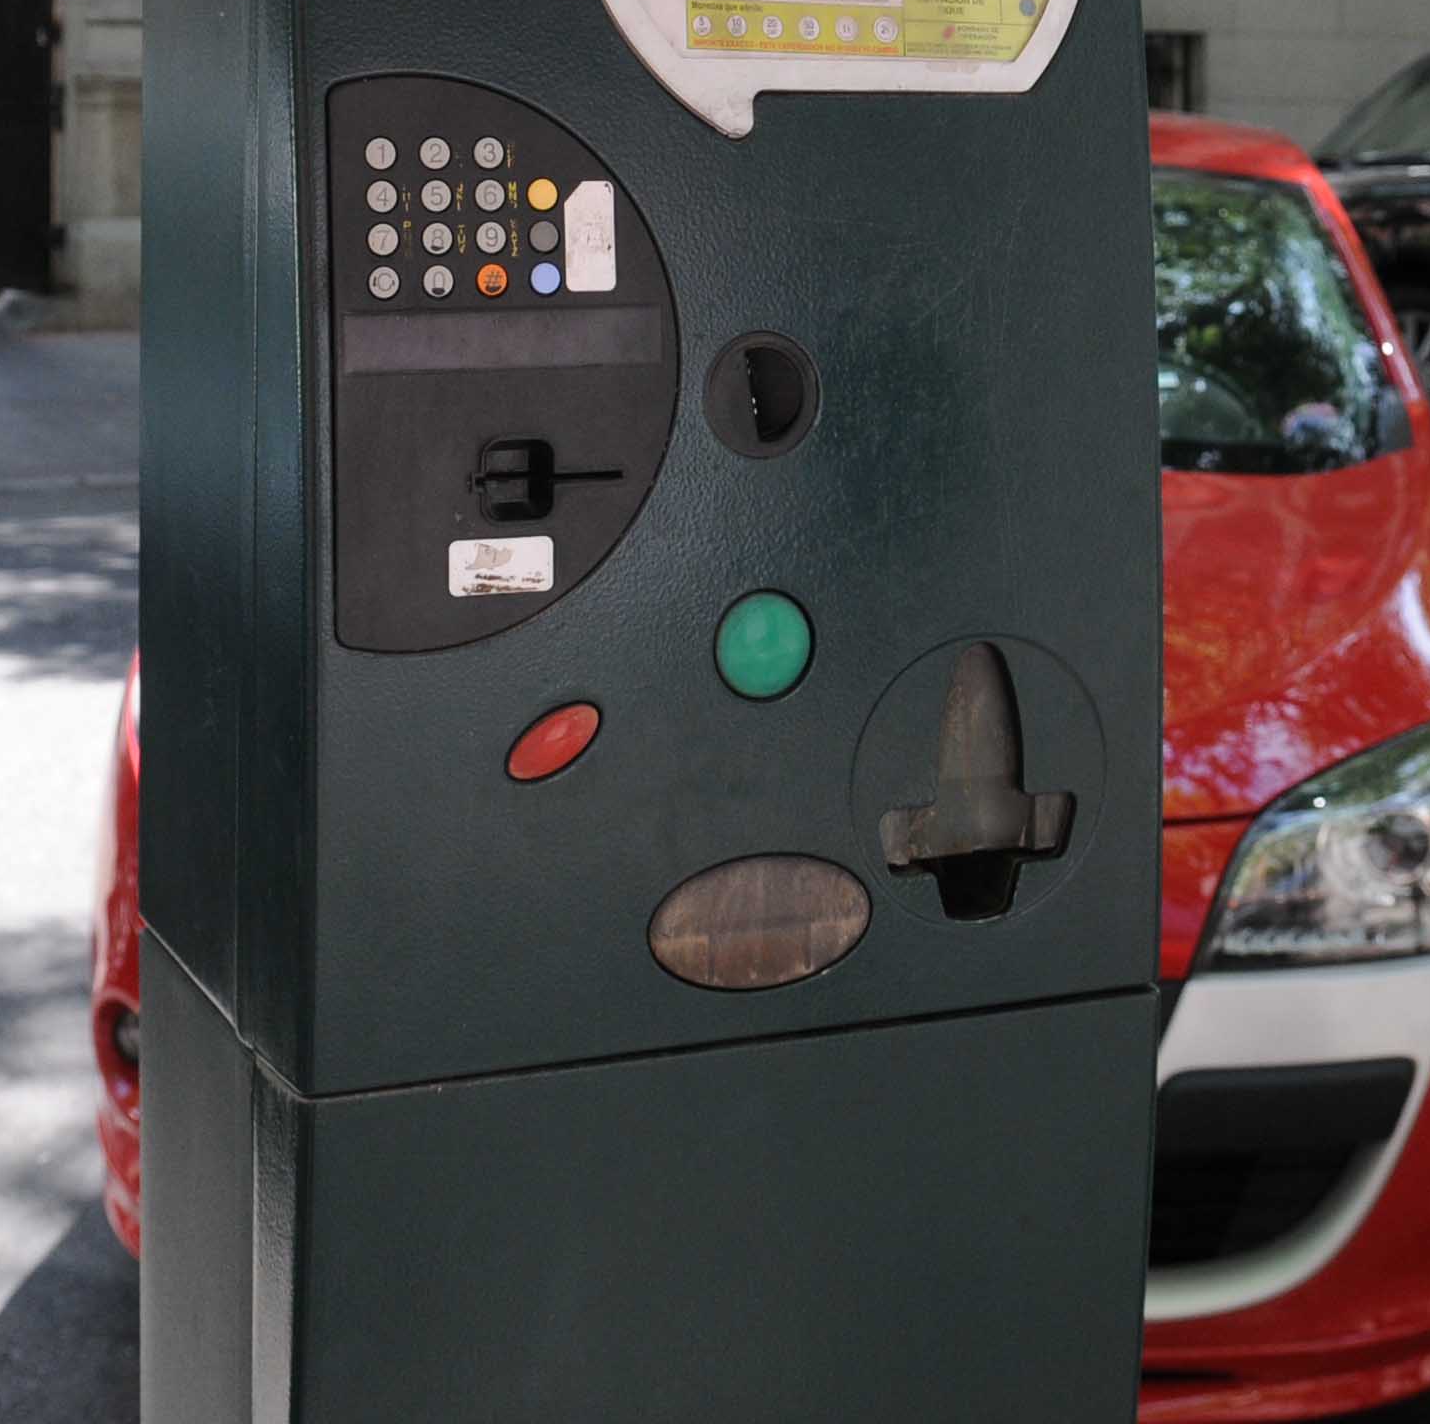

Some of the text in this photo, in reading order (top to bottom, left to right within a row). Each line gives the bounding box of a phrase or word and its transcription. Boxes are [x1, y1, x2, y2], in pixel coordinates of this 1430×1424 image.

[429, 143, 443, 164] 2
[483, 142, 496, 163] 3
[377, 187, 389, 208] 4
[430, 186, 444, 206] 5
[484, 185, 498, 206] 6
[374, 230, 390, 250] 7
[485, 227, 499, 248] 9
